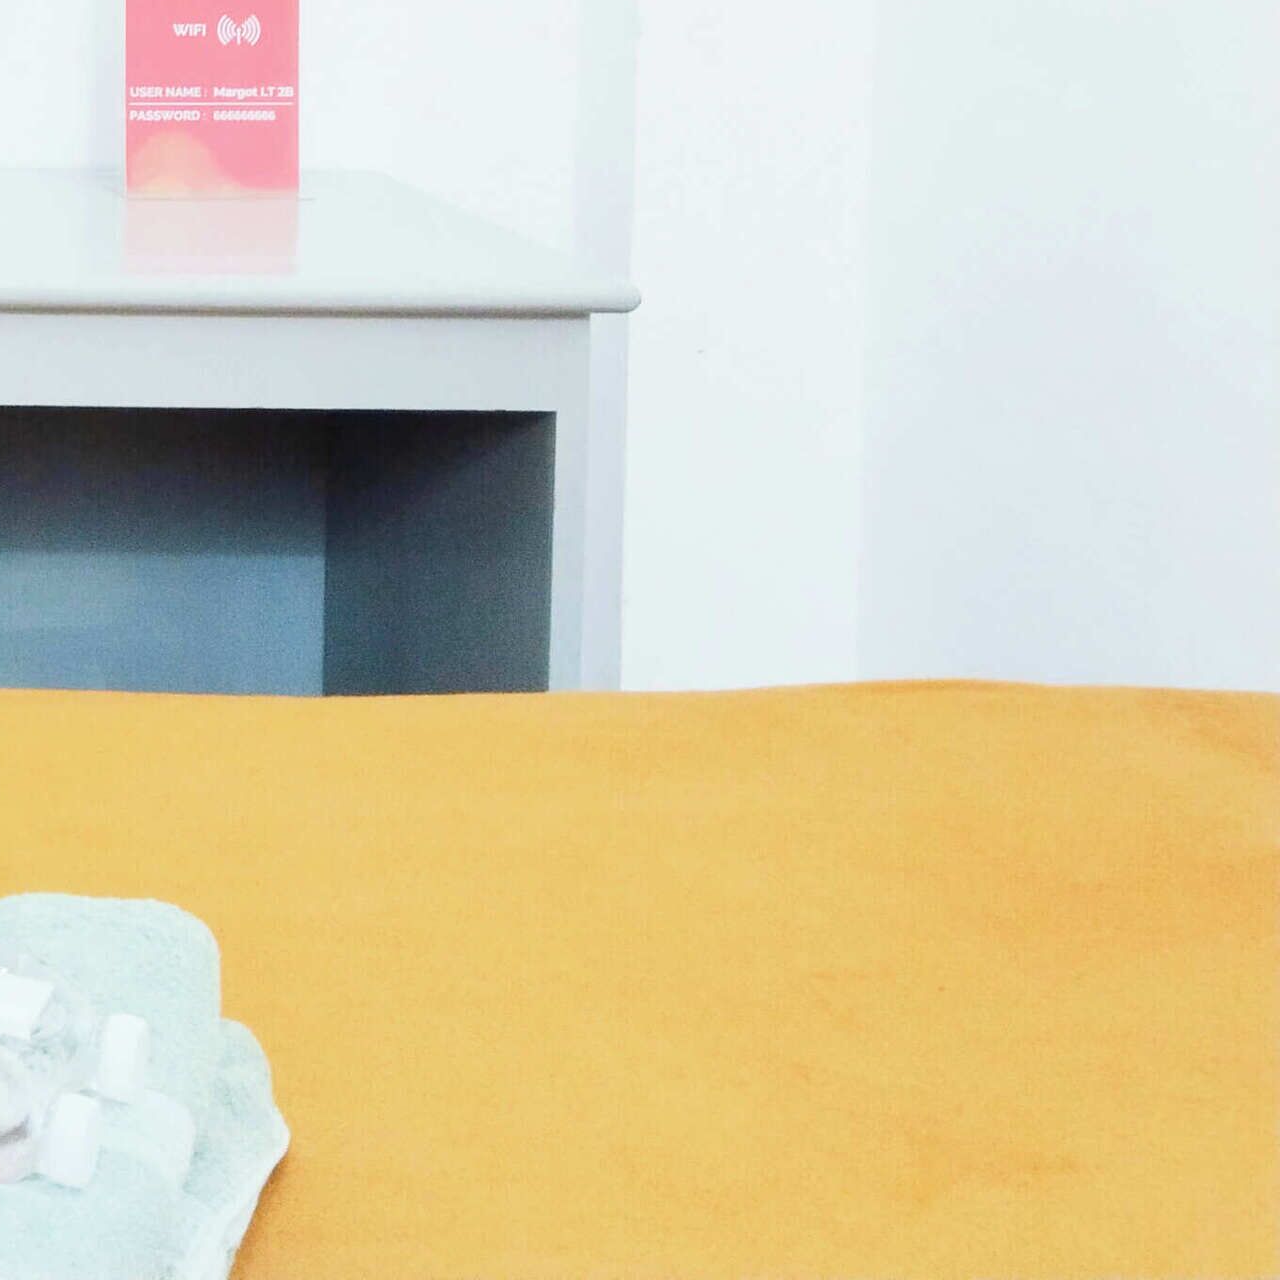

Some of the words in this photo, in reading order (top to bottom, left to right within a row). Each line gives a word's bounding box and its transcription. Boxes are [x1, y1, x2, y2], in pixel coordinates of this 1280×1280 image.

[172, 22, 207, 37] WIFI
[129, 85, 163, 98] USER
[213, 85, 258, 100] Margot
[129, 109, 201, 121] PASSWORD
